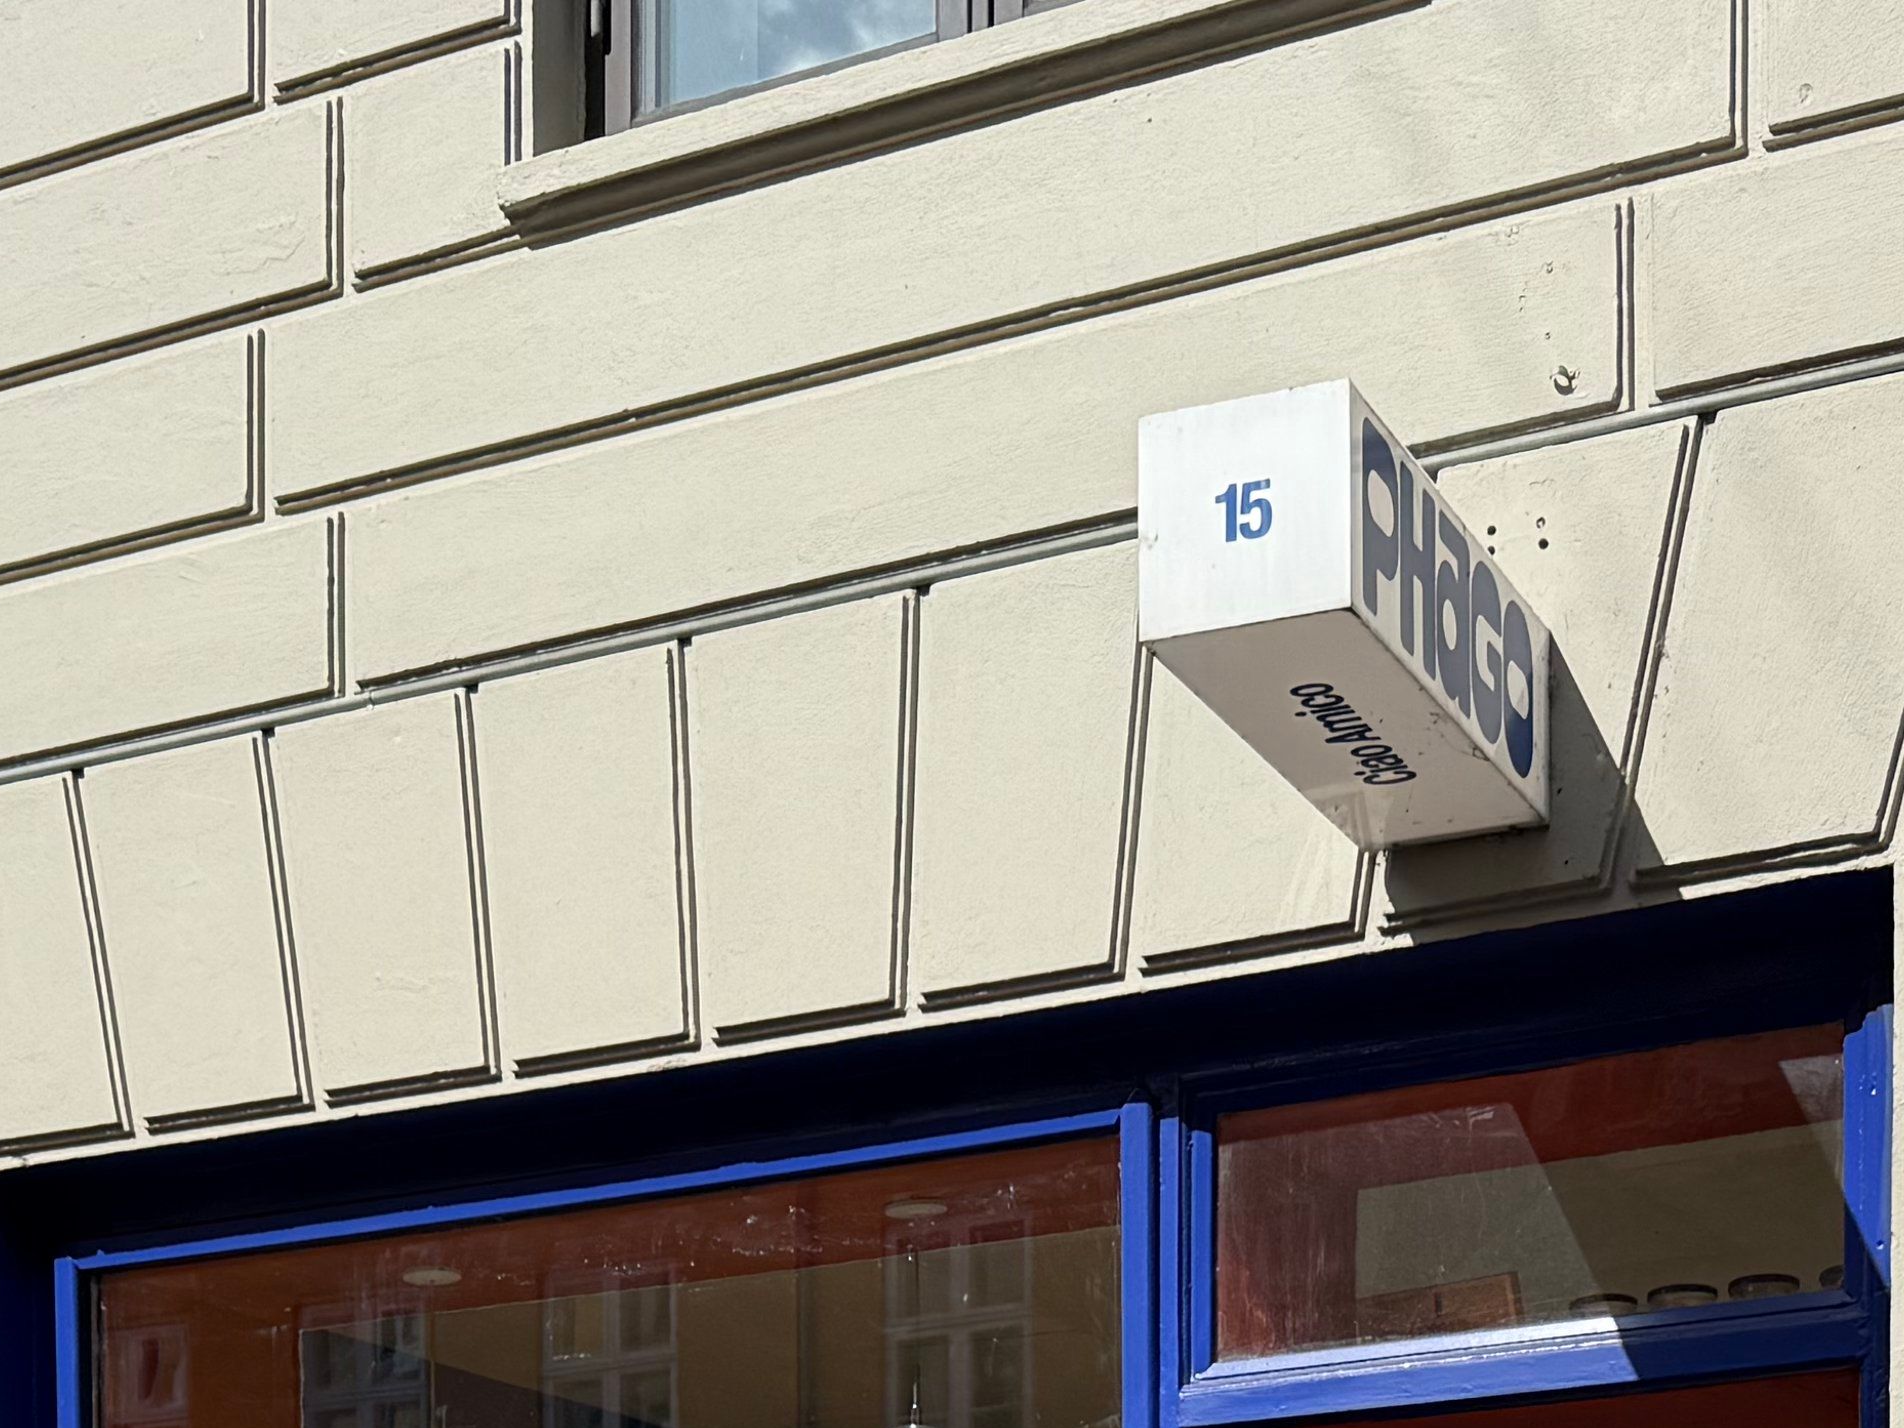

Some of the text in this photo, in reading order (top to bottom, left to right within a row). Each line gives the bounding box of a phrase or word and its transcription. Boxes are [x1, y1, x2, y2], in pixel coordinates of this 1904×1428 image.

[1215, 479, 1272, 542] 15
[1289, 682, 1417, 786] Ciao Amico
